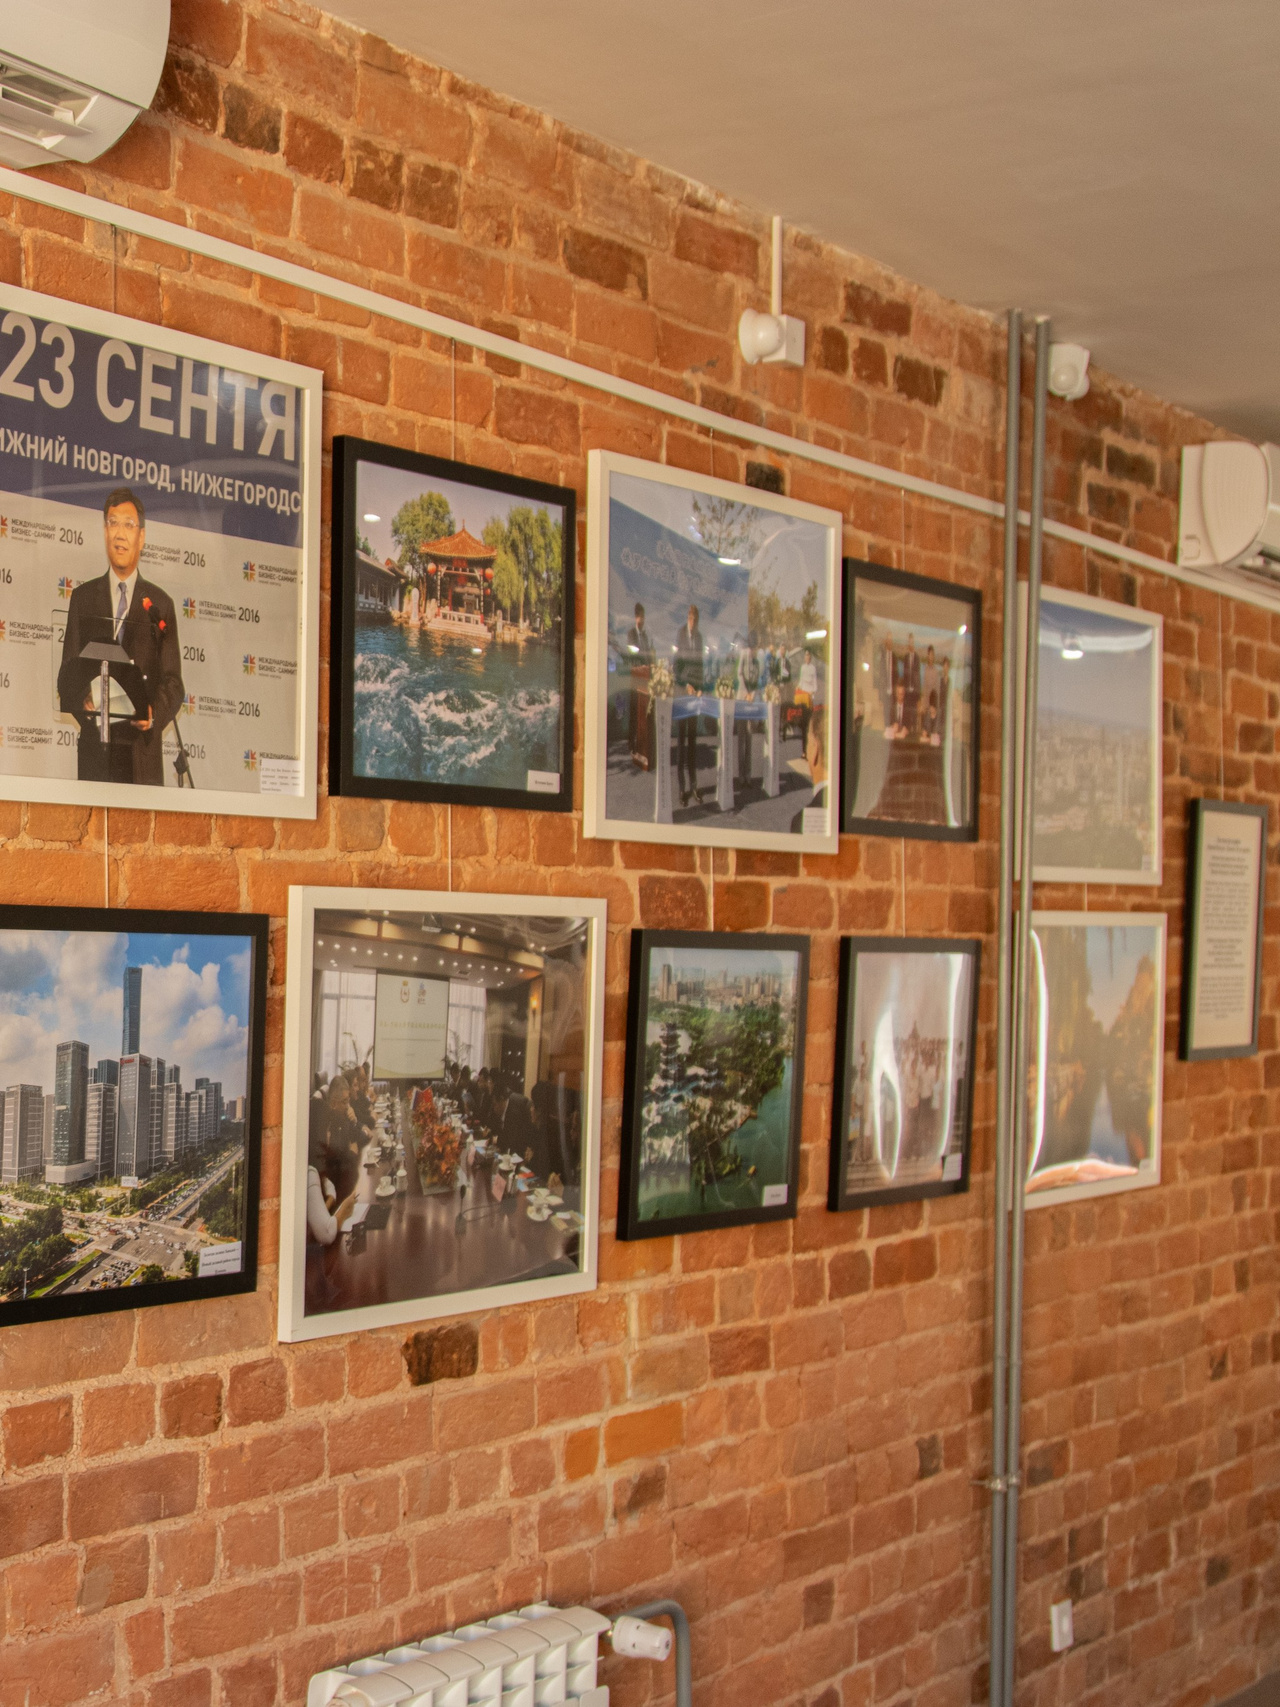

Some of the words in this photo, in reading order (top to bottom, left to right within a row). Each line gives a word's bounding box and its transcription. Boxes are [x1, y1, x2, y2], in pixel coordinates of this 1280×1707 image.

[95, 337, 296, 461] СЕНТЯ
[73, 443, 176, 493] НОВГОРОД,
[180, 468, 302, 516] НИЖЕГОРОДС
[11, 518, 57, 532] МЕЖДУНАРОДНЫЙ
[11, 526, 56, 541] БИЗНЕС-САММИТ
[58, 527, 84, 546] 2016
[183, 550, 206, 568] 2016
[198, 600, 236, 613] INTERNATIONAL
[198, 609, 220, 618] BUSINESS
[238, 606, 261, 624] 2016
[183, 645, 206, 663] 2016
[198, 703, 220, 713] BUSINESS
[238, 700, 261, 718] 2016
[7, 725, 54, 736] МЕЖДУНАРОДНЫЙ
